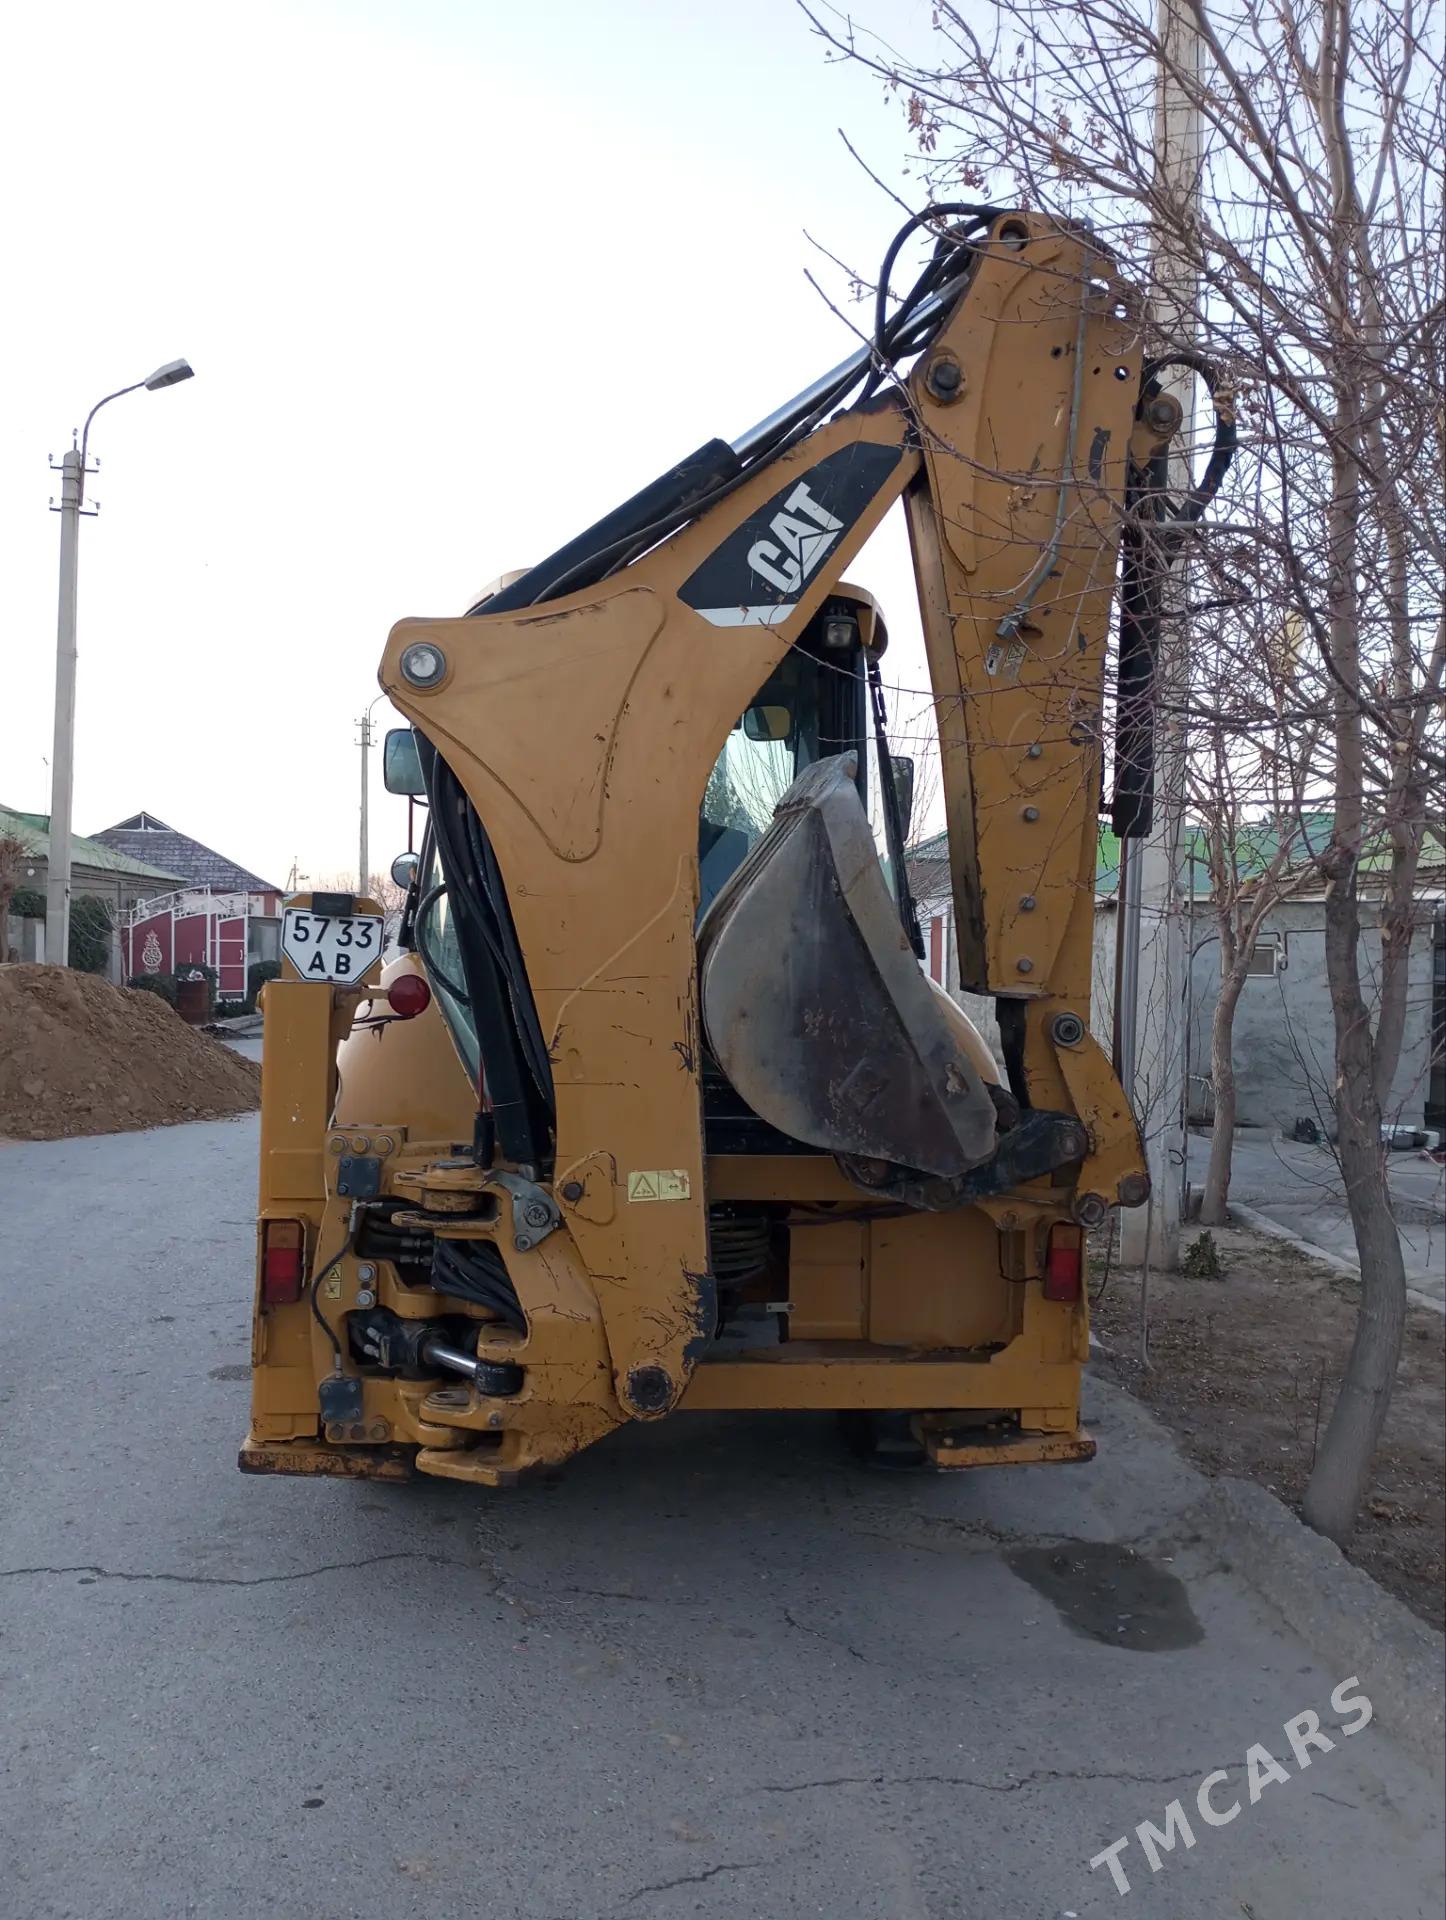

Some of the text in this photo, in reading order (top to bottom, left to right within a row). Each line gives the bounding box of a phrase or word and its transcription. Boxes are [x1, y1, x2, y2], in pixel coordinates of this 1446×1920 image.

[747, 481, 845, 593] CAT
[292, 915, 374, 949] 5733
[307, 950, 352, 975] AB
